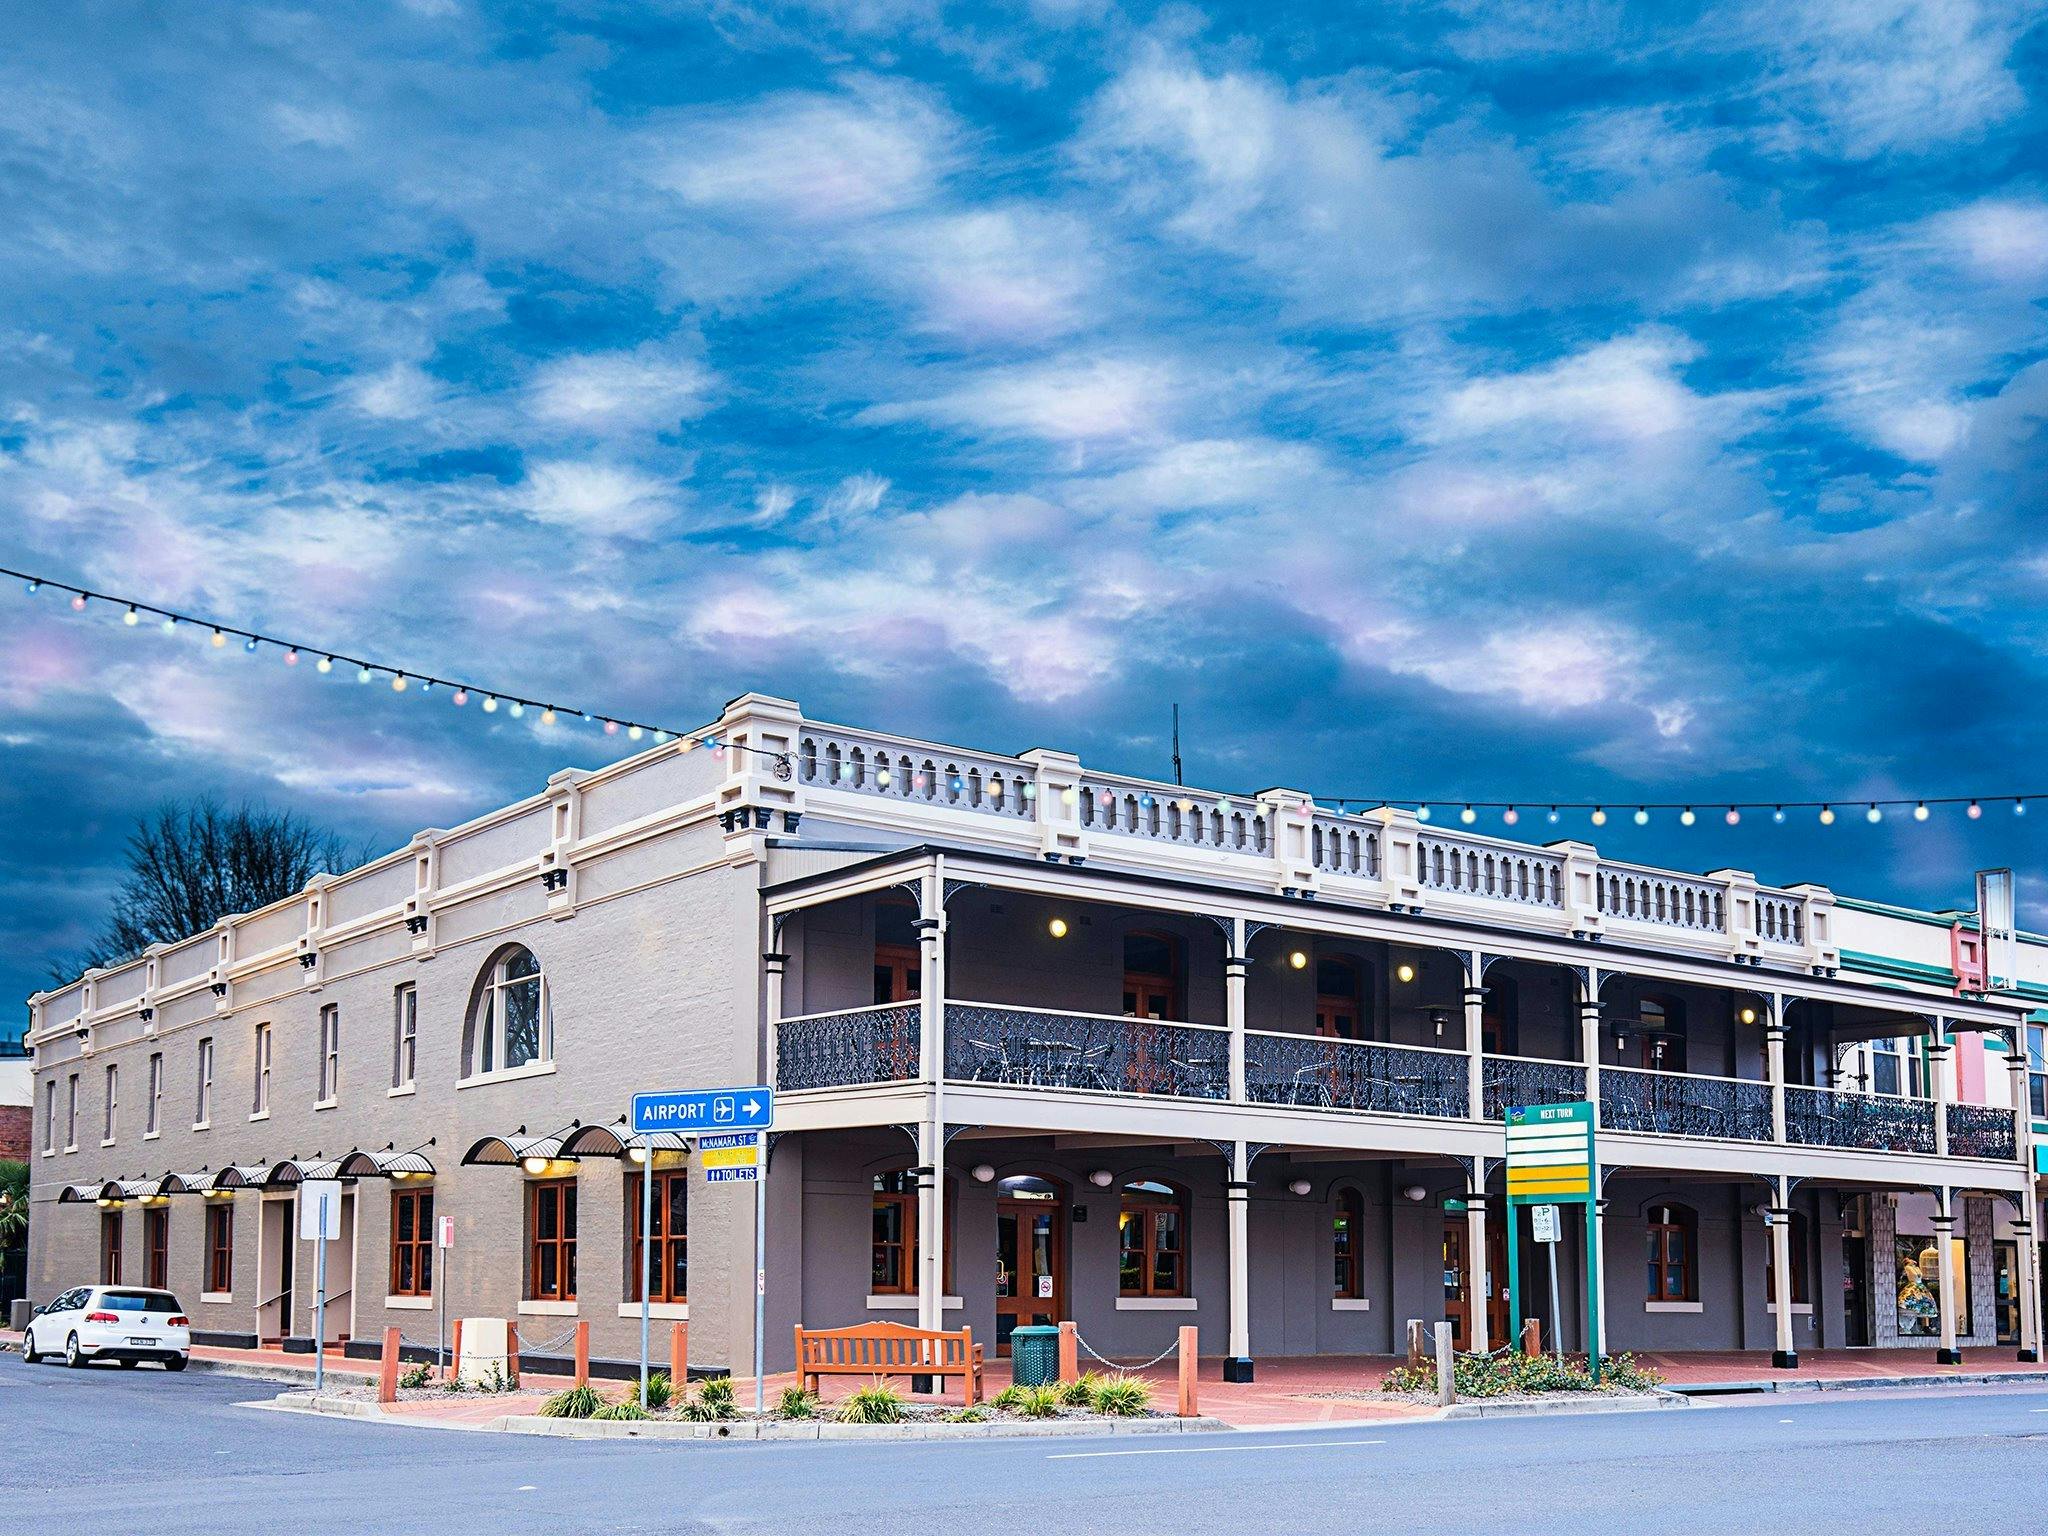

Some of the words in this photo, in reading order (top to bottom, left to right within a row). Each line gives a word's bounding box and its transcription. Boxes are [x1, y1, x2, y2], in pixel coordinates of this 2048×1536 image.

[643, 1103, 706, 1121] AIRPORT
[1540, 1109, 1555, 1119] NEXT
[1557, 1108, 1573, 1118] TURN
[738, 1135, 747, 1146] ST
[720, 1169, 754, 1180] TOILETS
